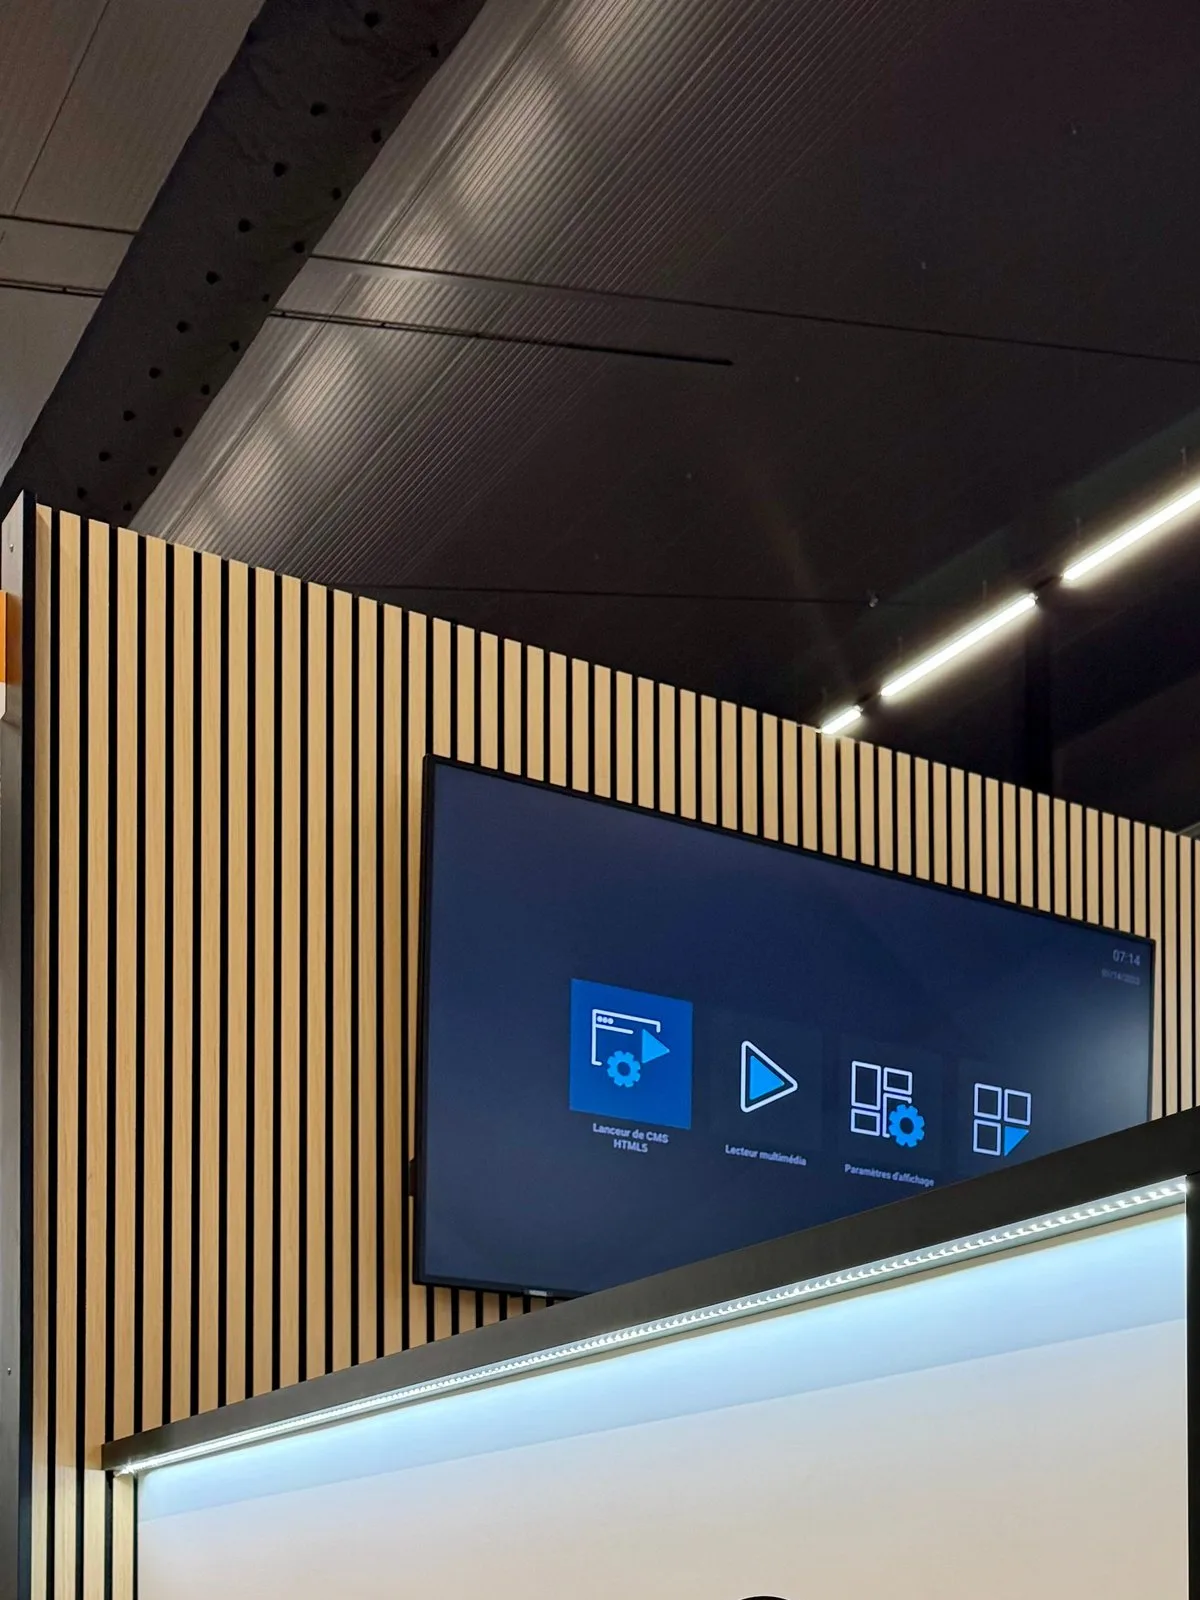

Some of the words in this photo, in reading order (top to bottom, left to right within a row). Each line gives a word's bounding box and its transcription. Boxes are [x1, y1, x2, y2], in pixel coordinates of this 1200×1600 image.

[592, 1122, 631, 1139] Lanceur
[632, 1129, 645, 1141] de
[646, 1131, 669, 1145] CMS
[613, 1139, 648, 1154] HTML5
[725, 1143, 758, 1159] Lecteur
[759, 1151, 807, 1167] multimédia
[844, 1163, 891, 1181] Paramètres
[892, 1171, 935, 1188] d'affichage
